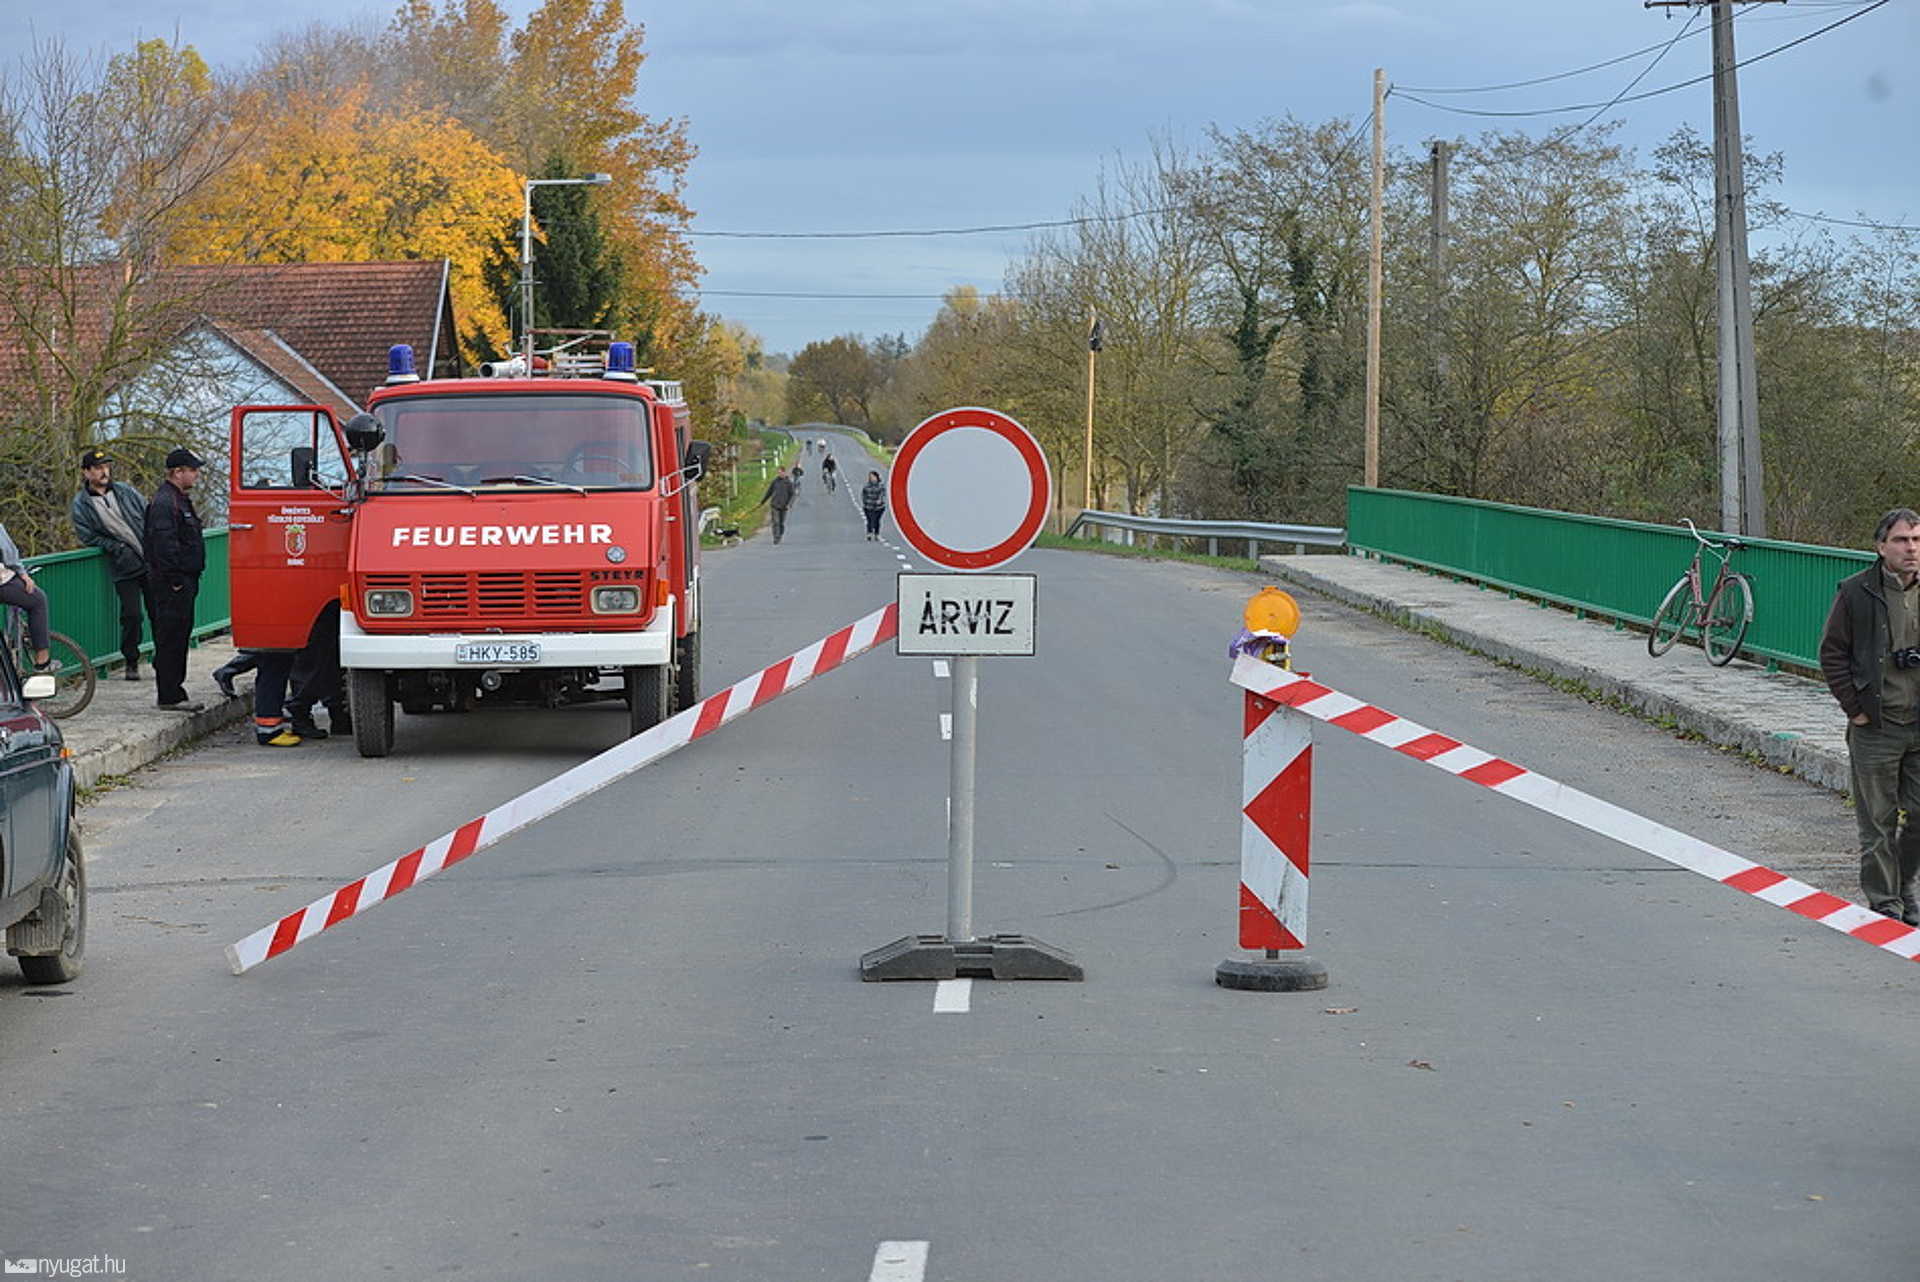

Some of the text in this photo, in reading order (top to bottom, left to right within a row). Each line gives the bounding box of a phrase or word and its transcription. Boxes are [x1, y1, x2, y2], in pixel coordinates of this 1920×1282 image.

[392, 524, 613, 547] FEUERWEHR
[590, 570, 645, 580] STEYR
[469, 645, 538, 659] HKY-585
